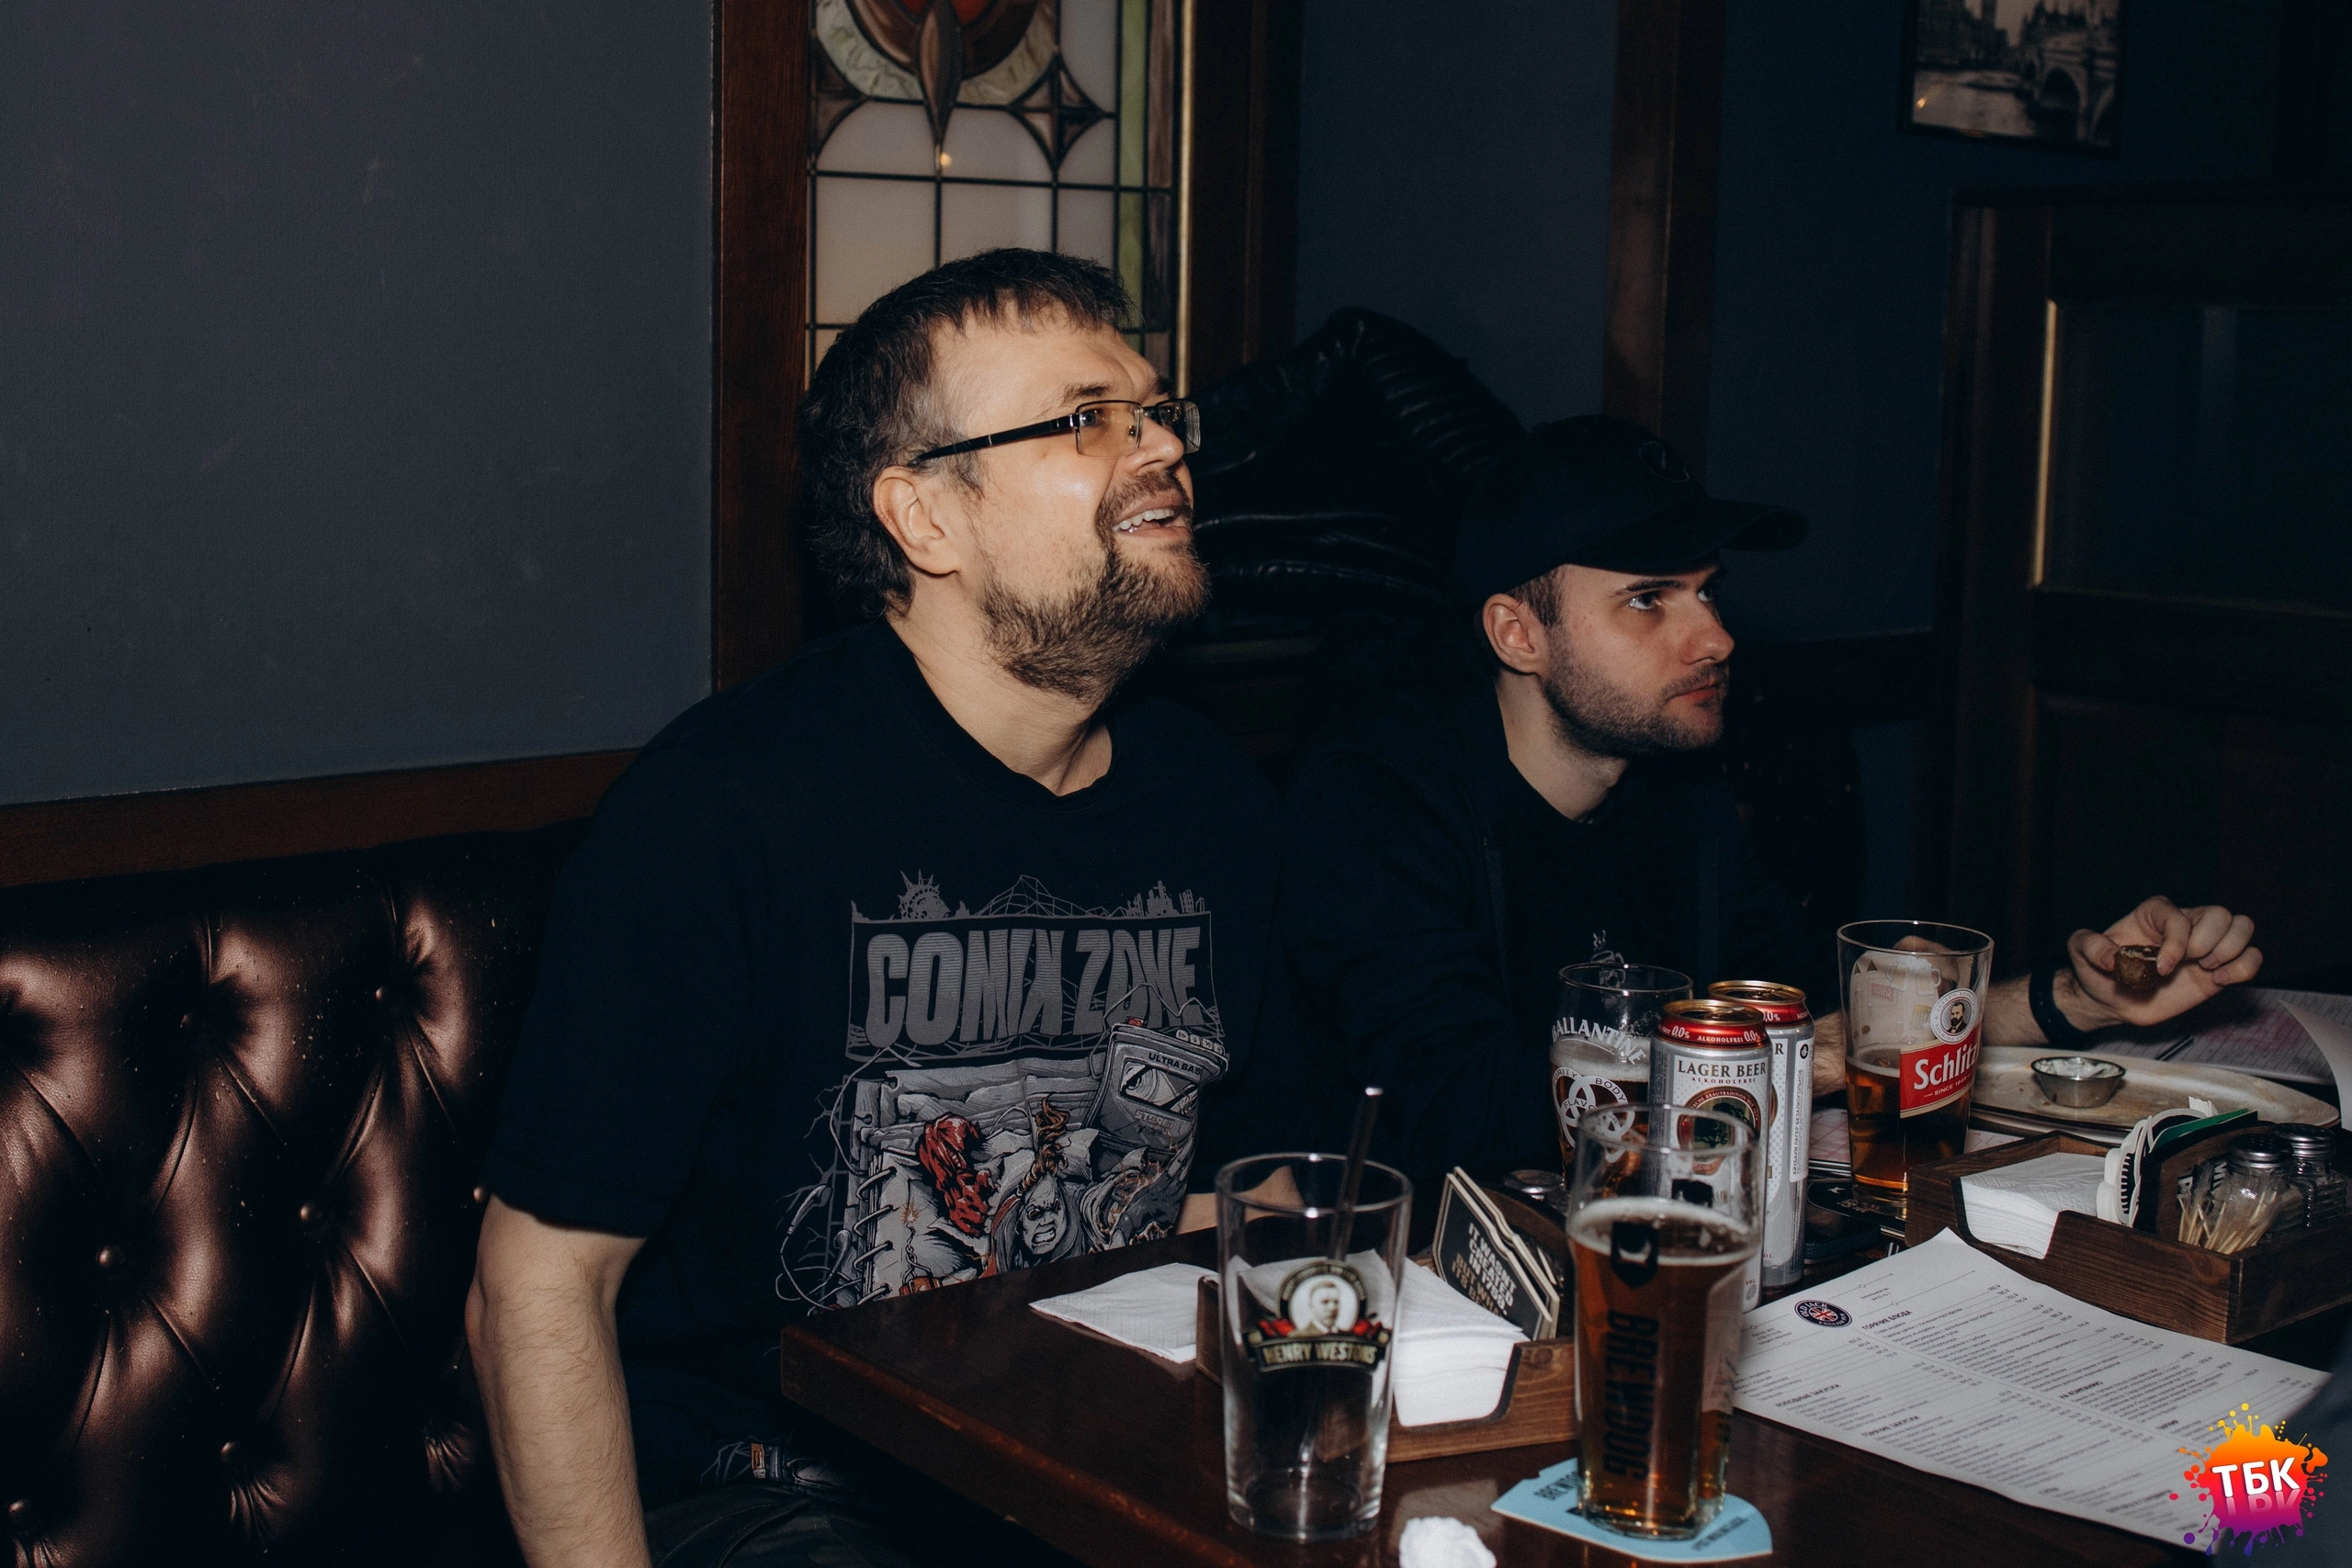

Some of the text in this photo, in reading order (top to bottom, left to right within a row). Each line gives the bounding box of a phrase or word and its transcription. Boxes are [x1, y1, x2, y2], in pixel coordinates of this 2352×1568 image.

[865, 926, 1201, 1048] COMIX ZONE
[1551, 1016, 1647, 1066] BALLANTINE
[1697, 1035, 1743, 1043] ALKOHOLFREI
[1148, 1052, 1180, 1069] ULTRA
[1678, 1059, 1767, 1078] LAGER BEER
[1914, 1043, 1978, 1090] Schlitz
[1595, 1077, 1626, 1101] BODY
[1934, 1083, 1954, 1096] SINCE
[1469, 1223, 1480, 1242] IT
[1456, 1252, 1477, 1285] BUT
[1469, 1252, 1481, 1276] IN
[1469, 1238, 1514, 1307] CREATED
[1799, 1301, 1828, 1317] OLD JACK
[1262, 1342, 1312, 1365] HENRY
[1604, 1309, 1660, 1480] BREWDOG
